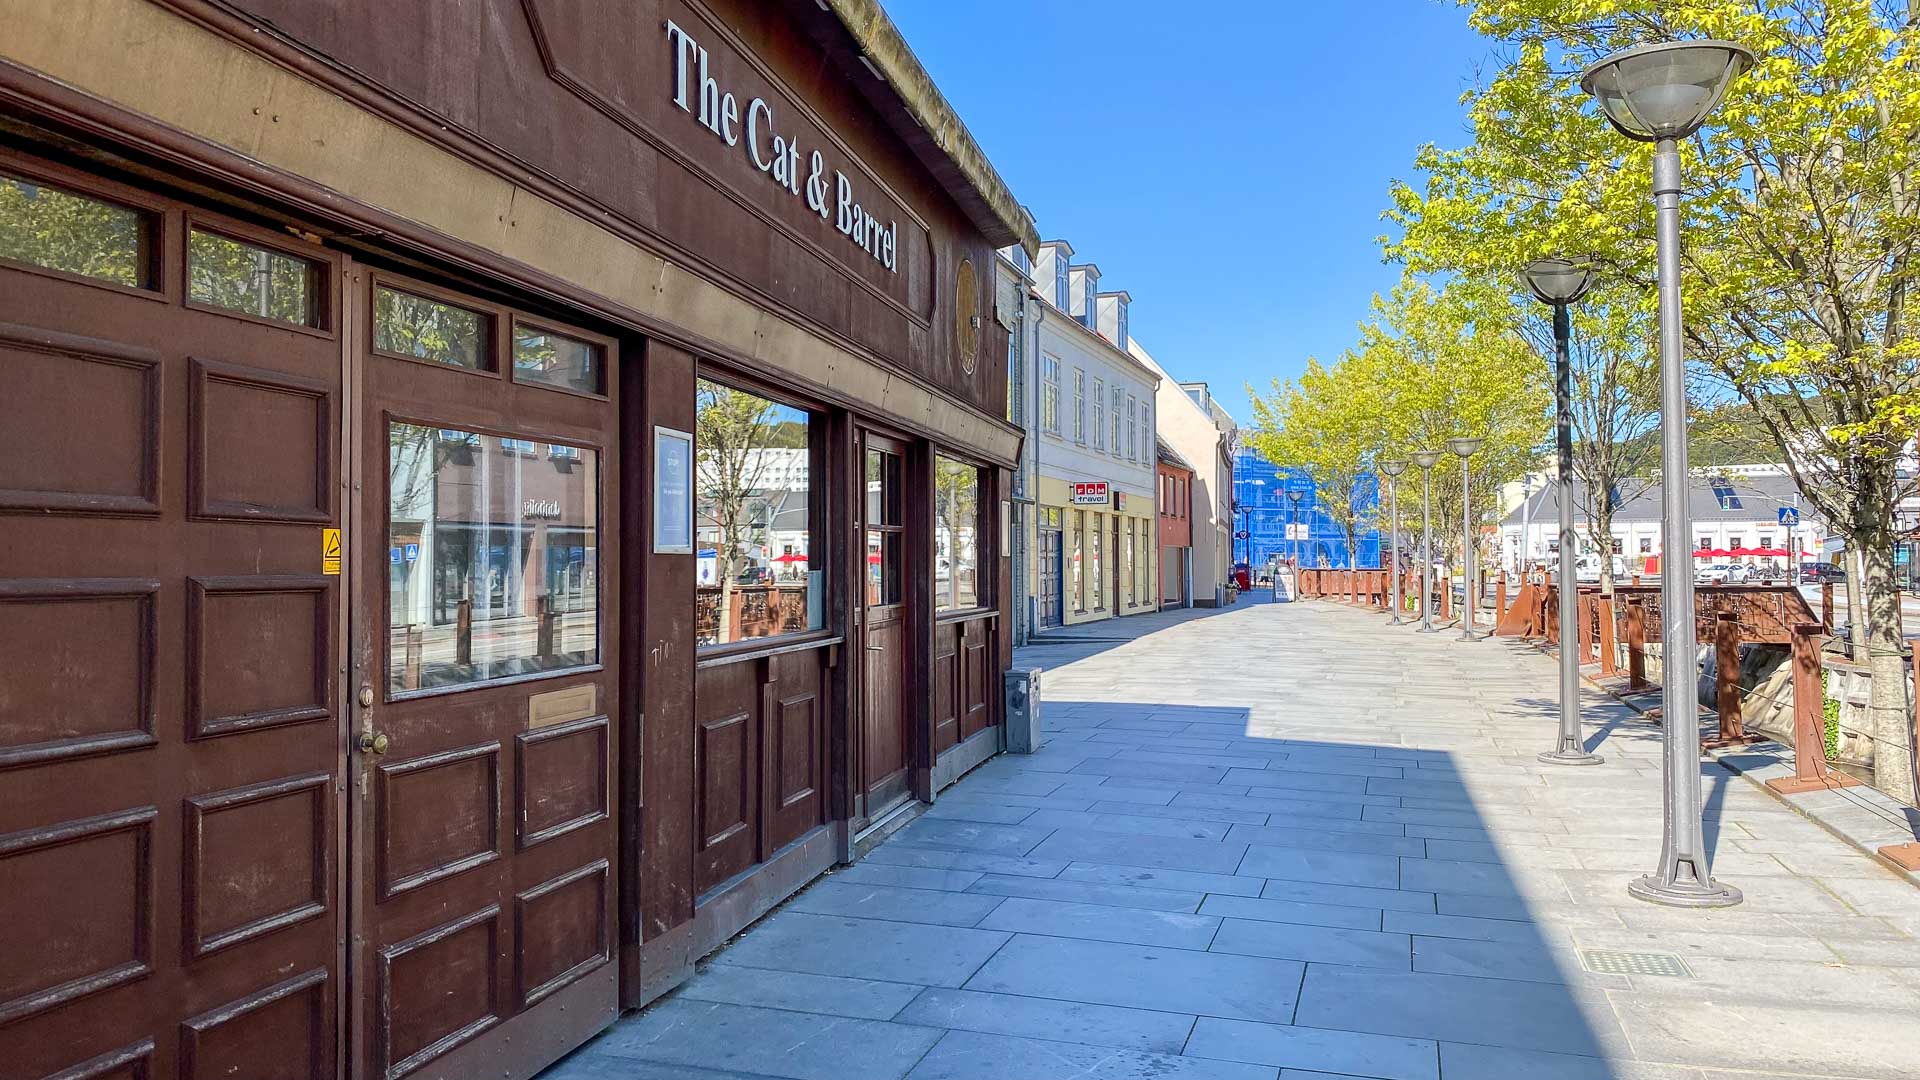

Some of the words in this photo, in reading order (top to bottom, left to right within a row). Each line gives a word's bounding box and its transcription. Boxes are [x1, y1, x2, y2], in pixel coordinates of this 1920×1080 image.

[666, 18, 738, 147] The
[747, 97, 800, 196] Cat
[806, 149, 830, 219] &
[835, 169, 898, 274] Barrel
[1077, 487, 1105, 495] FDM
